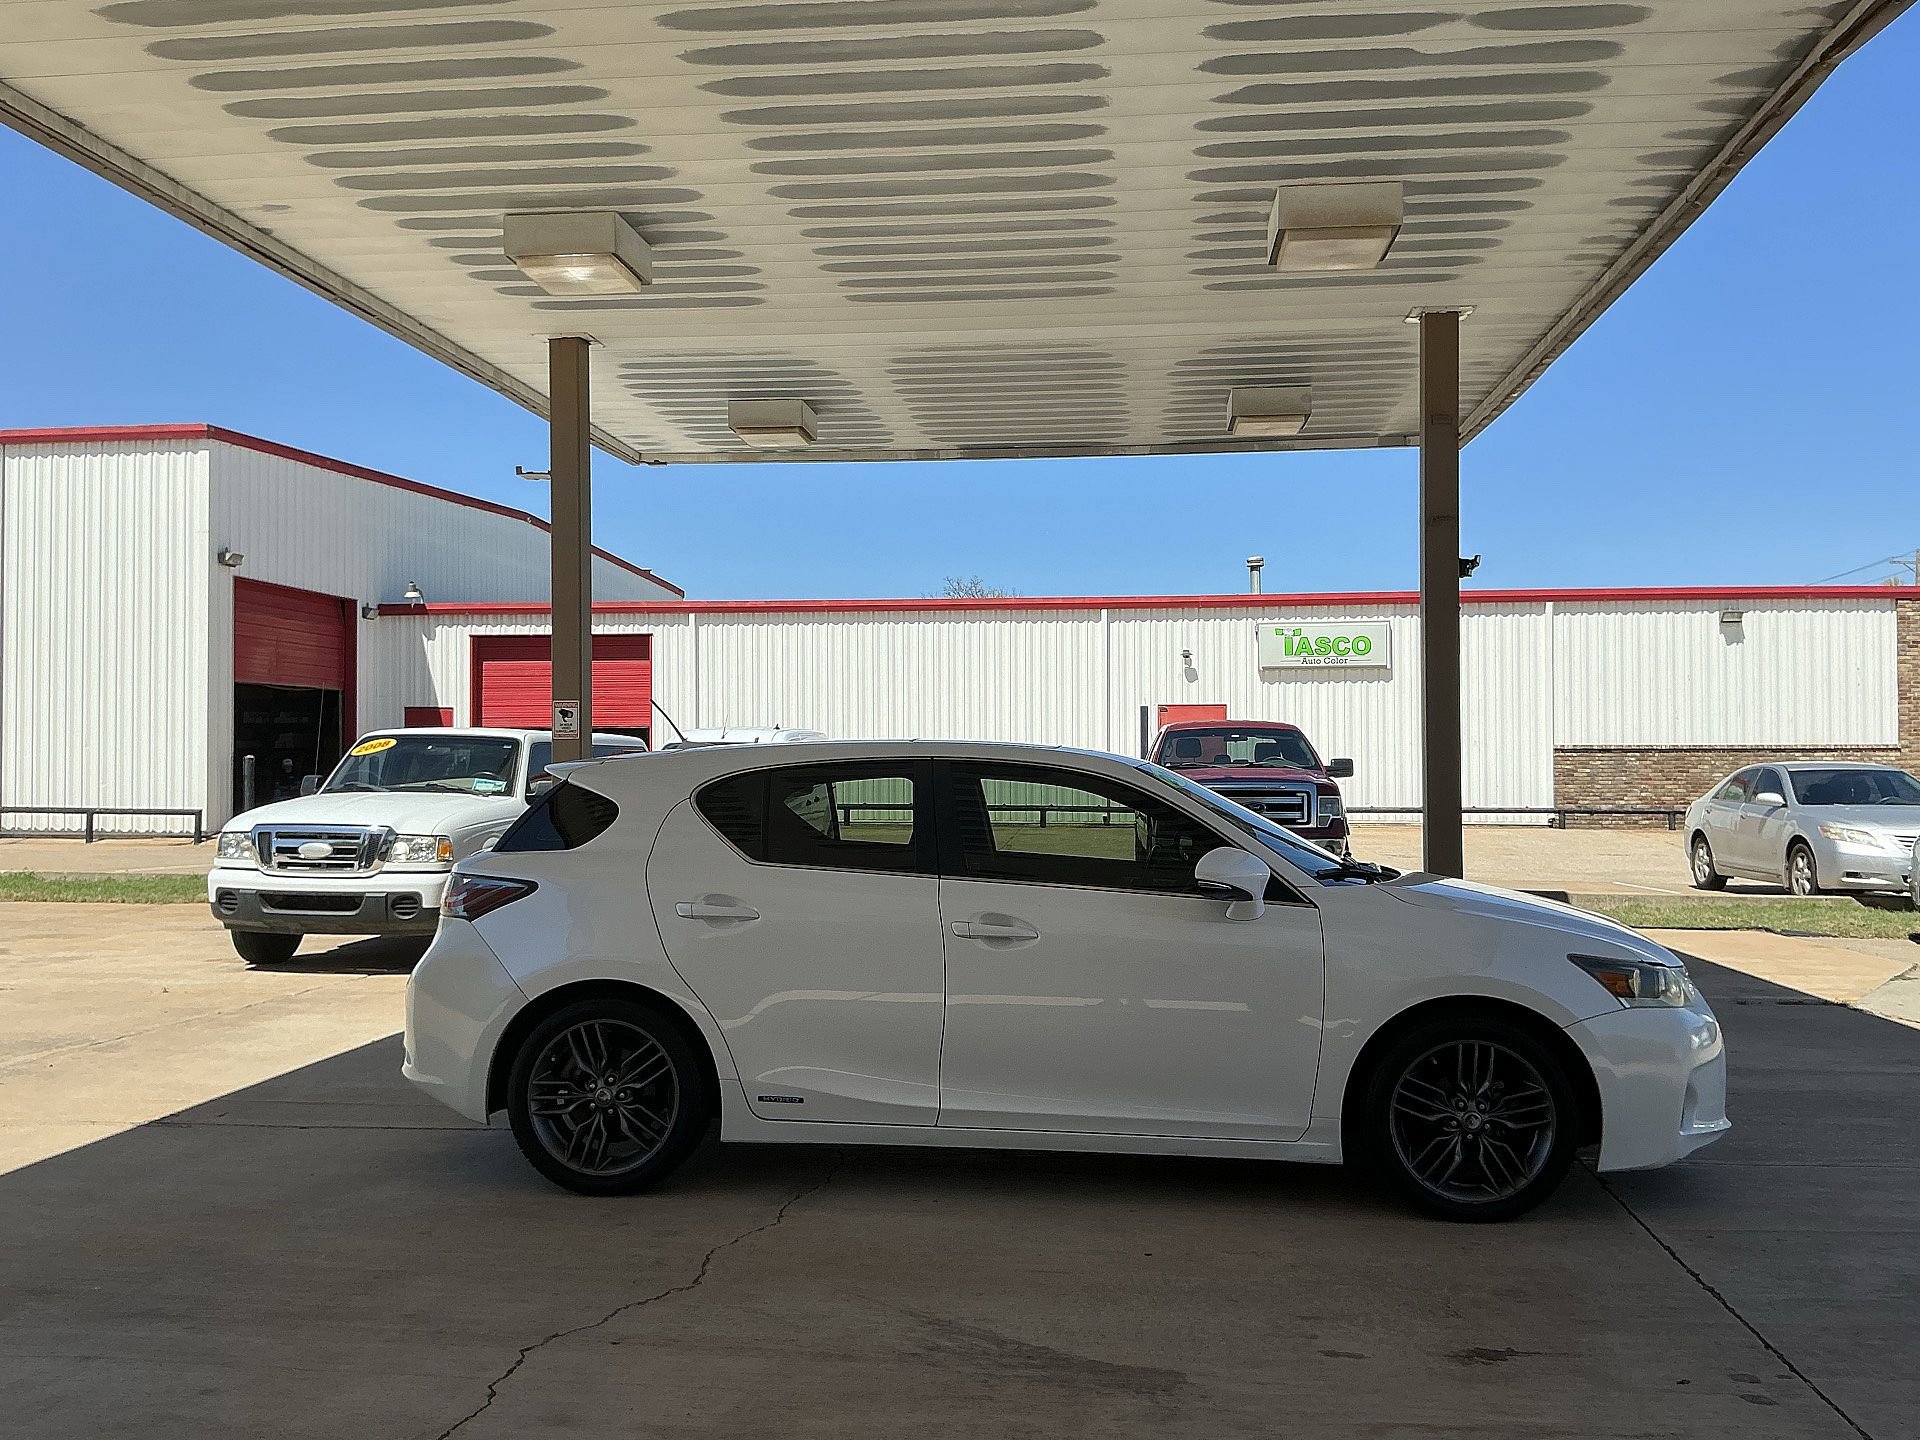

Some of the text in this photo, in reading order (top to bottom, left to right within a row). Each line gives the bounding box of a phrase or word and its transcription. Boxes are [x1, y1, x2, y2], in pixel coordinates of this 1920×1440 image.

[1275, 628, 1372, 657] TASCO
[1301, 657, 1349, 665] Auto Color
[355, 740, 391, 754] 2008
